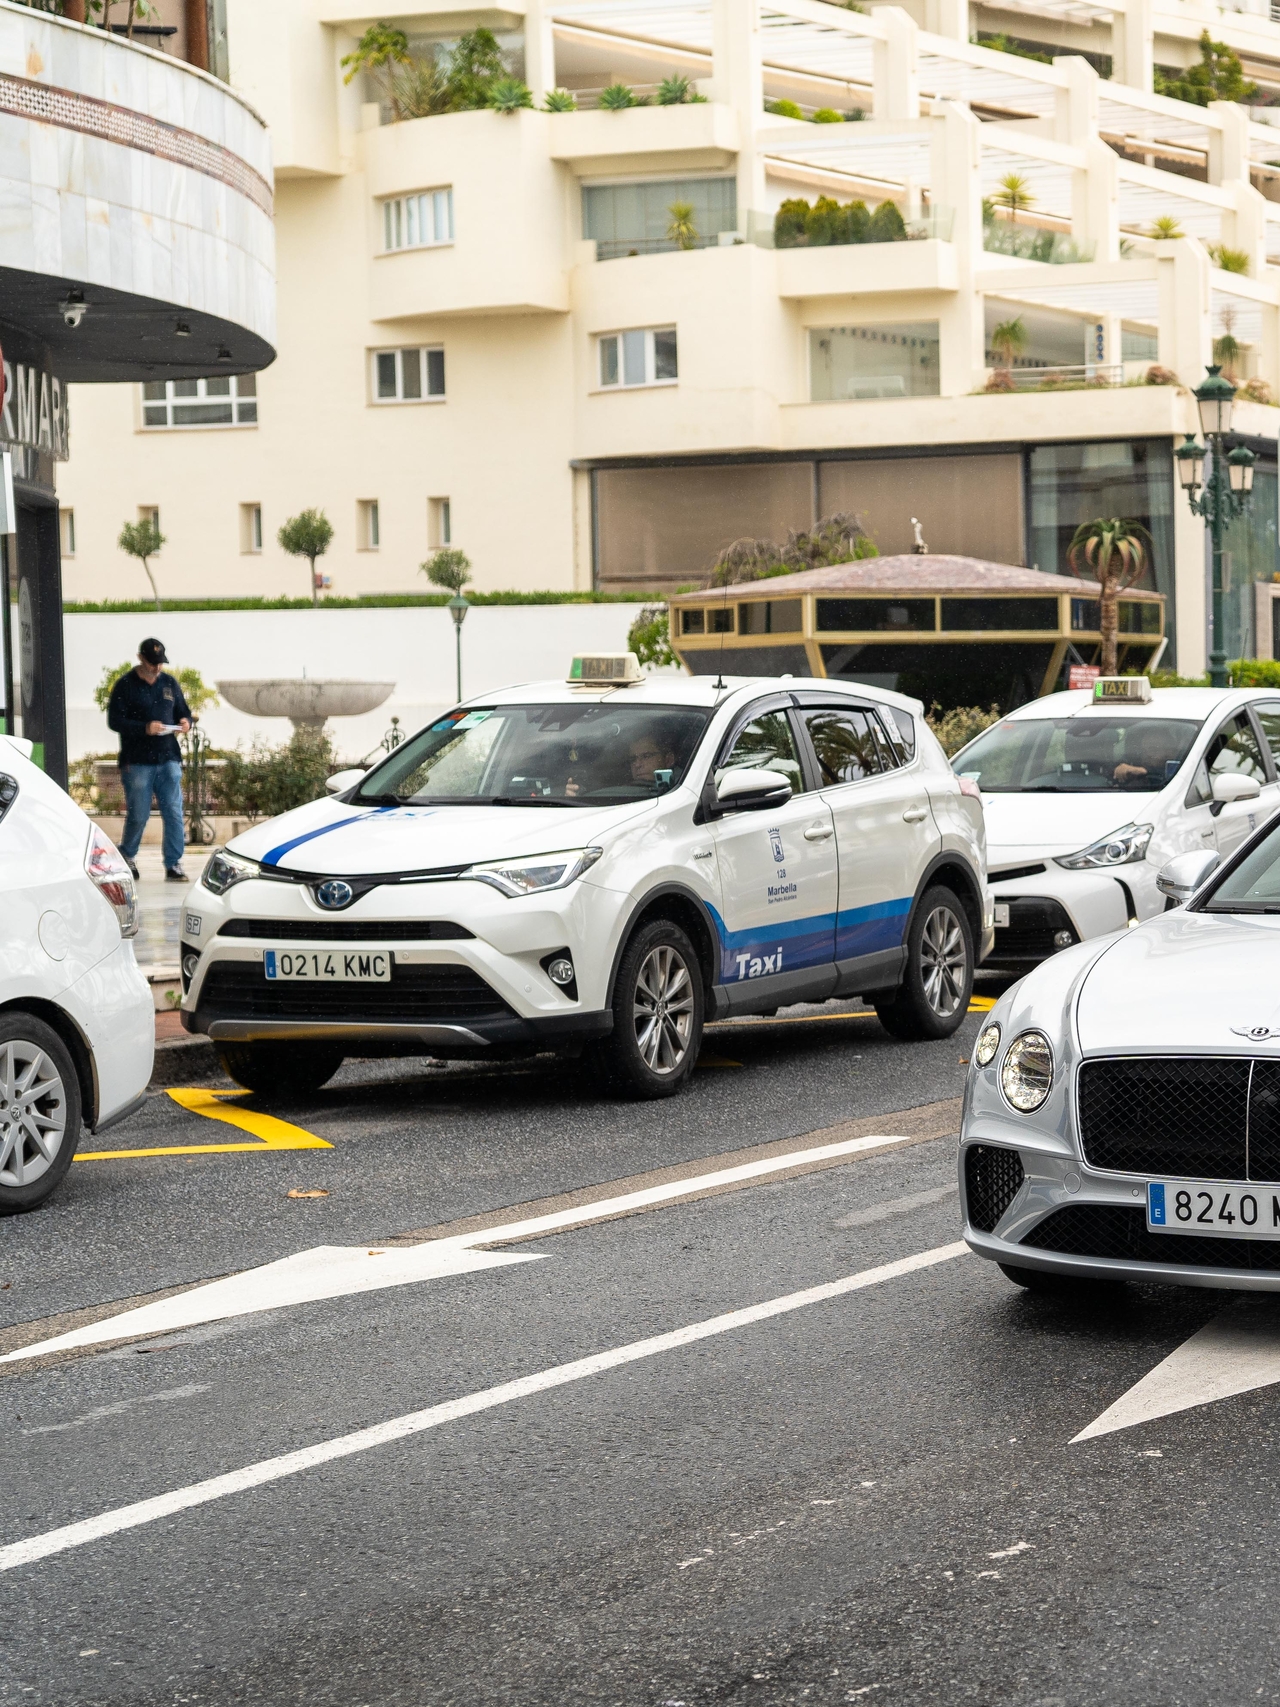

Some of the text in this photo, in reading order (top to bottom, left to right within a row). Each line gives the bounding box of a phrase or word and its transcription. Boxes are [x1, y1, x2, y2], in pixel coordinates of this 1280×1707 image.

[583, 659, 613, 677] TAXI
[1104, 682, 1129, 695] TAXI
[768, 883, 797, 896] Marbella
[187, 917, 199, 931] SP
[280, 954, 335, 976] 0214
[344, 955, 385, 977] KMC
[736, 946, 783, 980] Taxi
[1154, 1208, 1161, 1217] E
[1175, 1190, 1258, 1226] 8240
